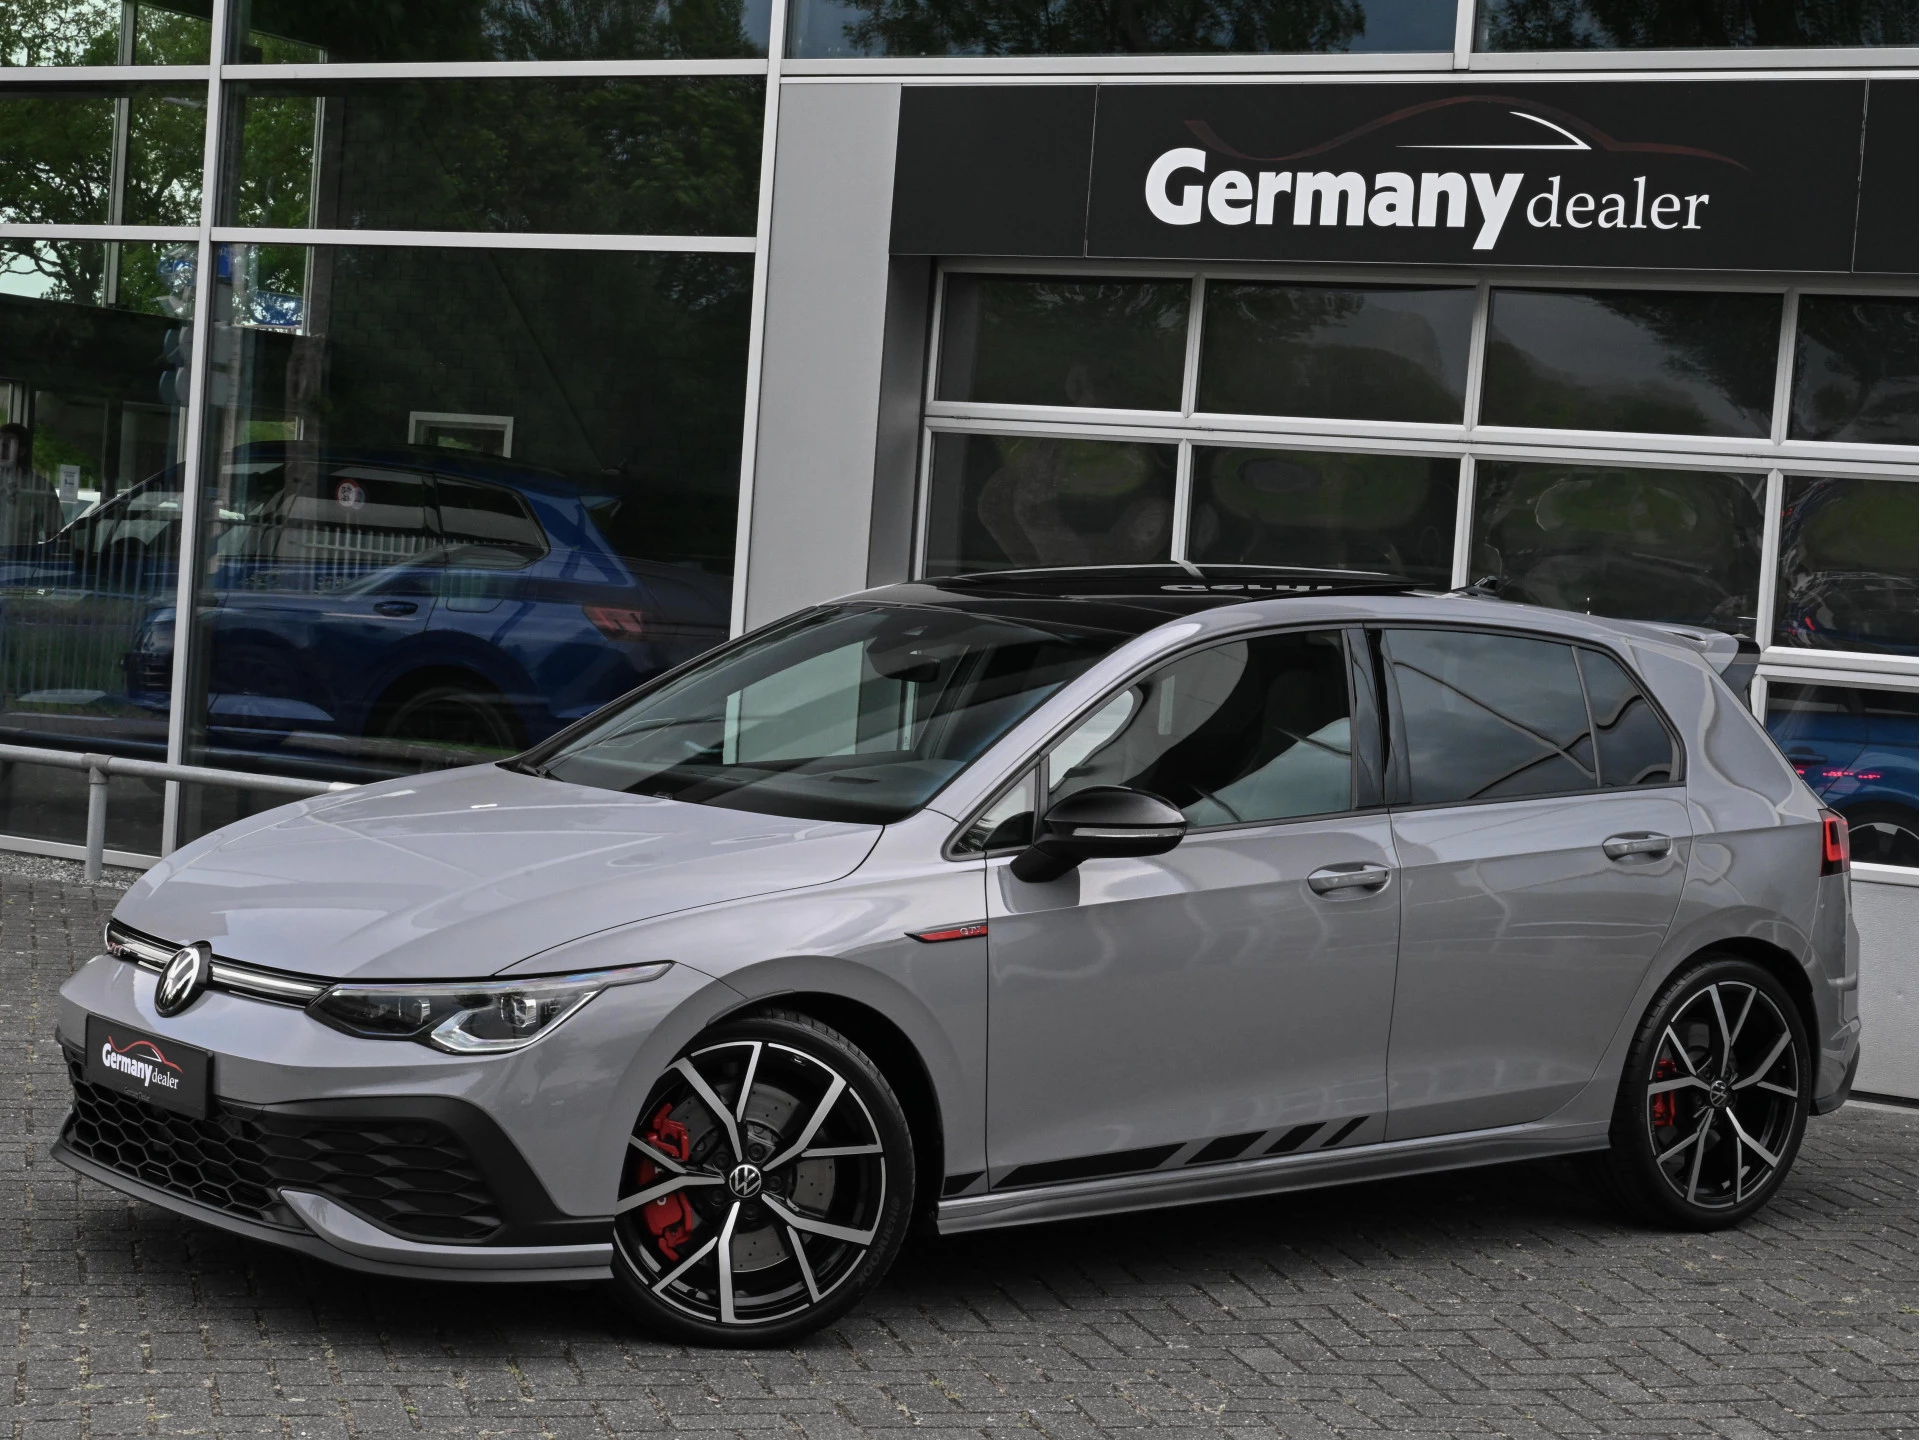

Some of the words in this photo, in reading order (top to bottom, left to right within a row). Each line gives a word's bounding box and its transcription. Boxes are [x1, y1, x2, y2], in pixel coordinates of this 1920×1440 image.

[1145, 148, 1524, 249] Germany
[1526, 176, 1709, 230] dealer
[102, 1043, 153, 1086] Germany
[152, 1067, 179, 1089] dealer
